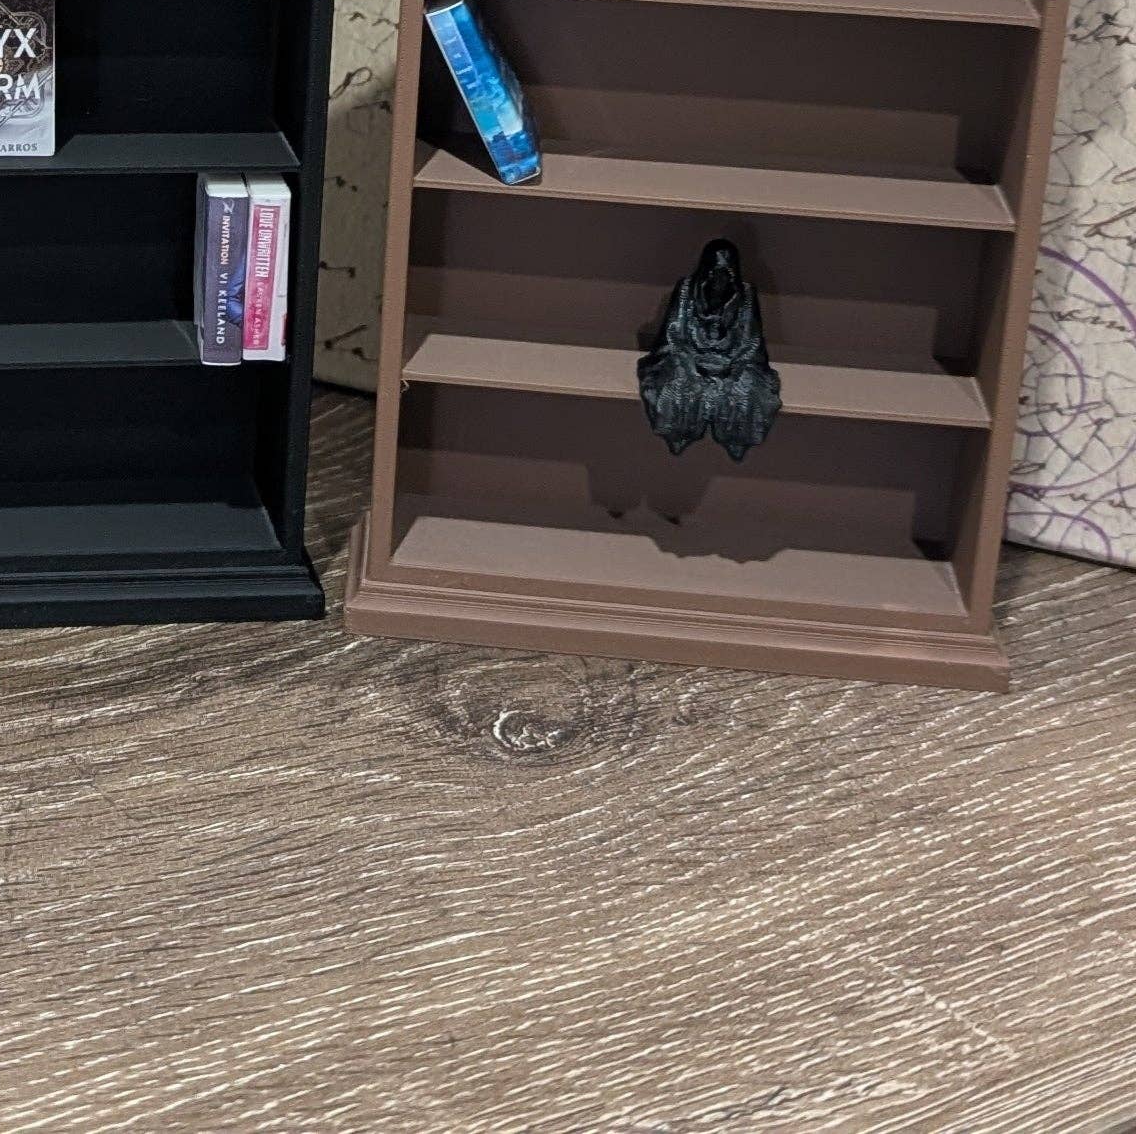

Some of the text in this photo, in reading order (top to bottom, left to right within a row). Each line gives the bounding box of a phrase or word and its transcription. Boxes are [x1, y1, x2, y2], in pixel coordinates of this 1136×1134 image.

[259, 208, 275, 232] LOVE
[220, 215, 231, 265] INVITATION
[219, 272, 229, 285] VI
[216, 292, 228, 344] KEELAND
